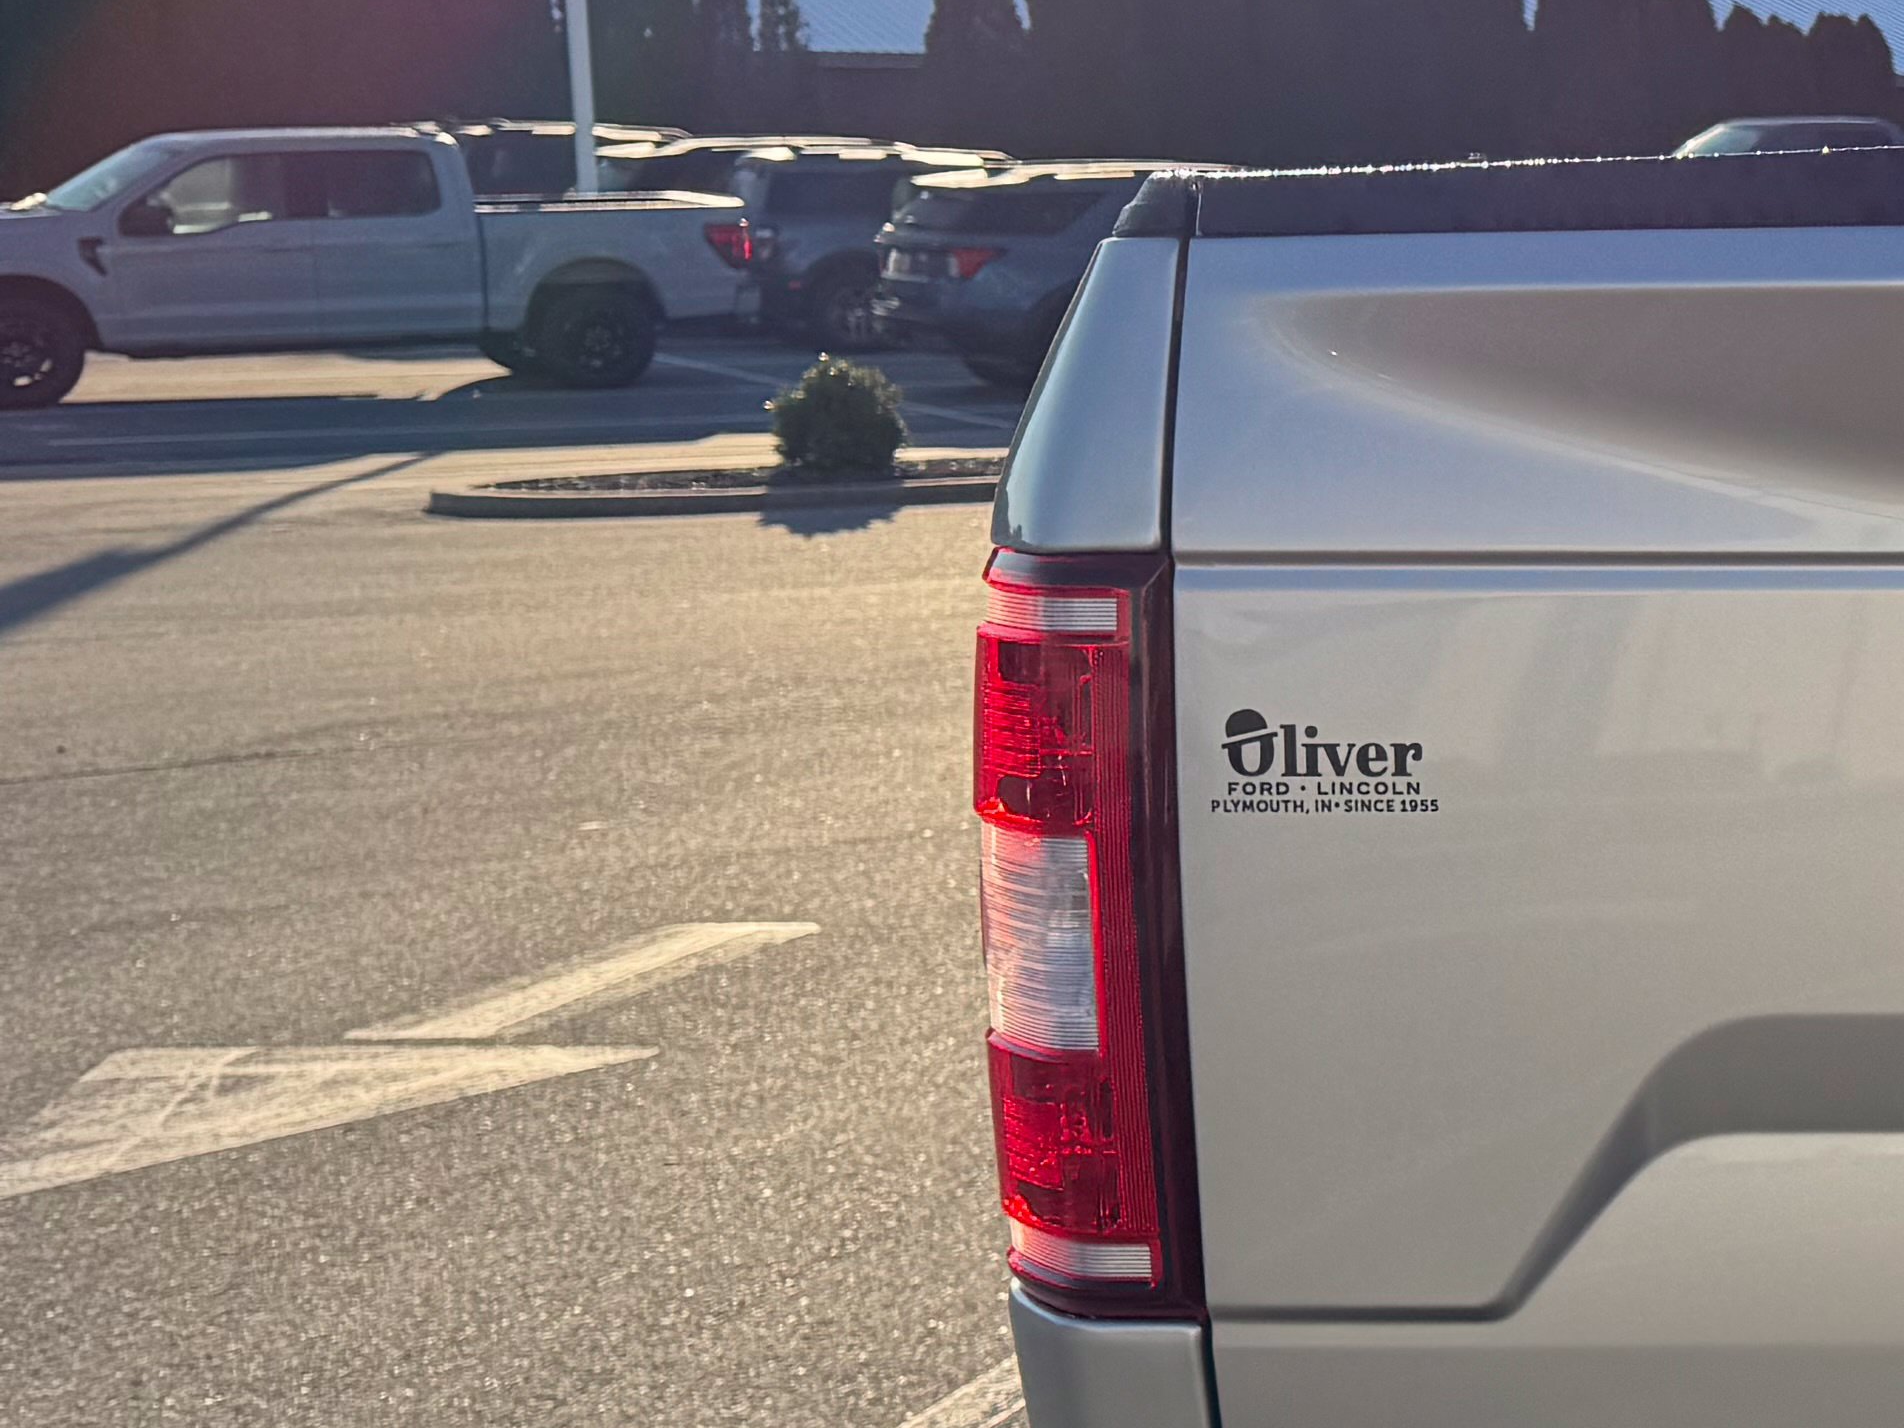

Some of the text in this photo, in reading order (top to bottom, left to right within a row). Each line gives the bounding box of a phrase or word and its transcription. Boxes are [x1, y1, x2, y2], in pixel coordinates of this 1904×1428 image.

[1221, 708, 1423, 777] Oliver
[1227, 781, 1420, 796] FORD LINCOLN
[1211, 799, 1310, 814] PLYMOUTH,
[1400, 799, 1440, 813] 1955
